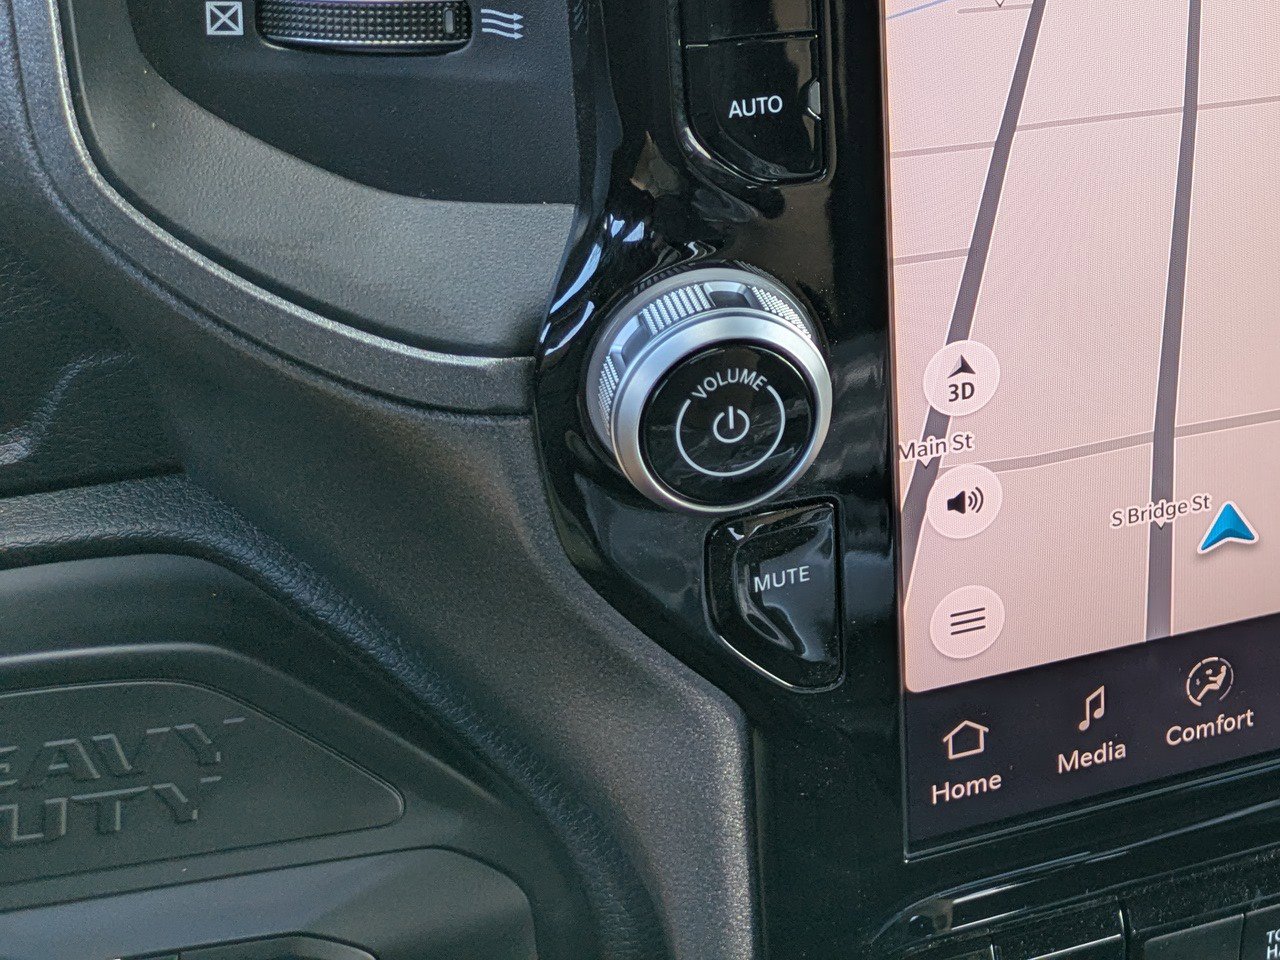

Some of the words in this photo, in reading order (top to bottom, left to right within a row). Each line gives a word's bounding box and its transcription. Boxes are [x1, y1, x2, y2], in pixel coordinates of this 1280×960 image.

[728, 95, 783, 119] AUTO
[691, 367, 768, 401] VOLUME
[948, 381, 975, 403] 3D
[898, 437, 947, 459] Main
[952, 433, 973, 451] St
[1111, 510, 1123, 527] S
[1127, 499, 1188, 525] Bridge
[1192, 495, 1210, 511] St
[753, 565, 810, 593] MUTE
[1166, 708, 1254, 746] Comfort
[1058, 741, 1126, 774] Media
[932, 773, 1002, 805] Home
